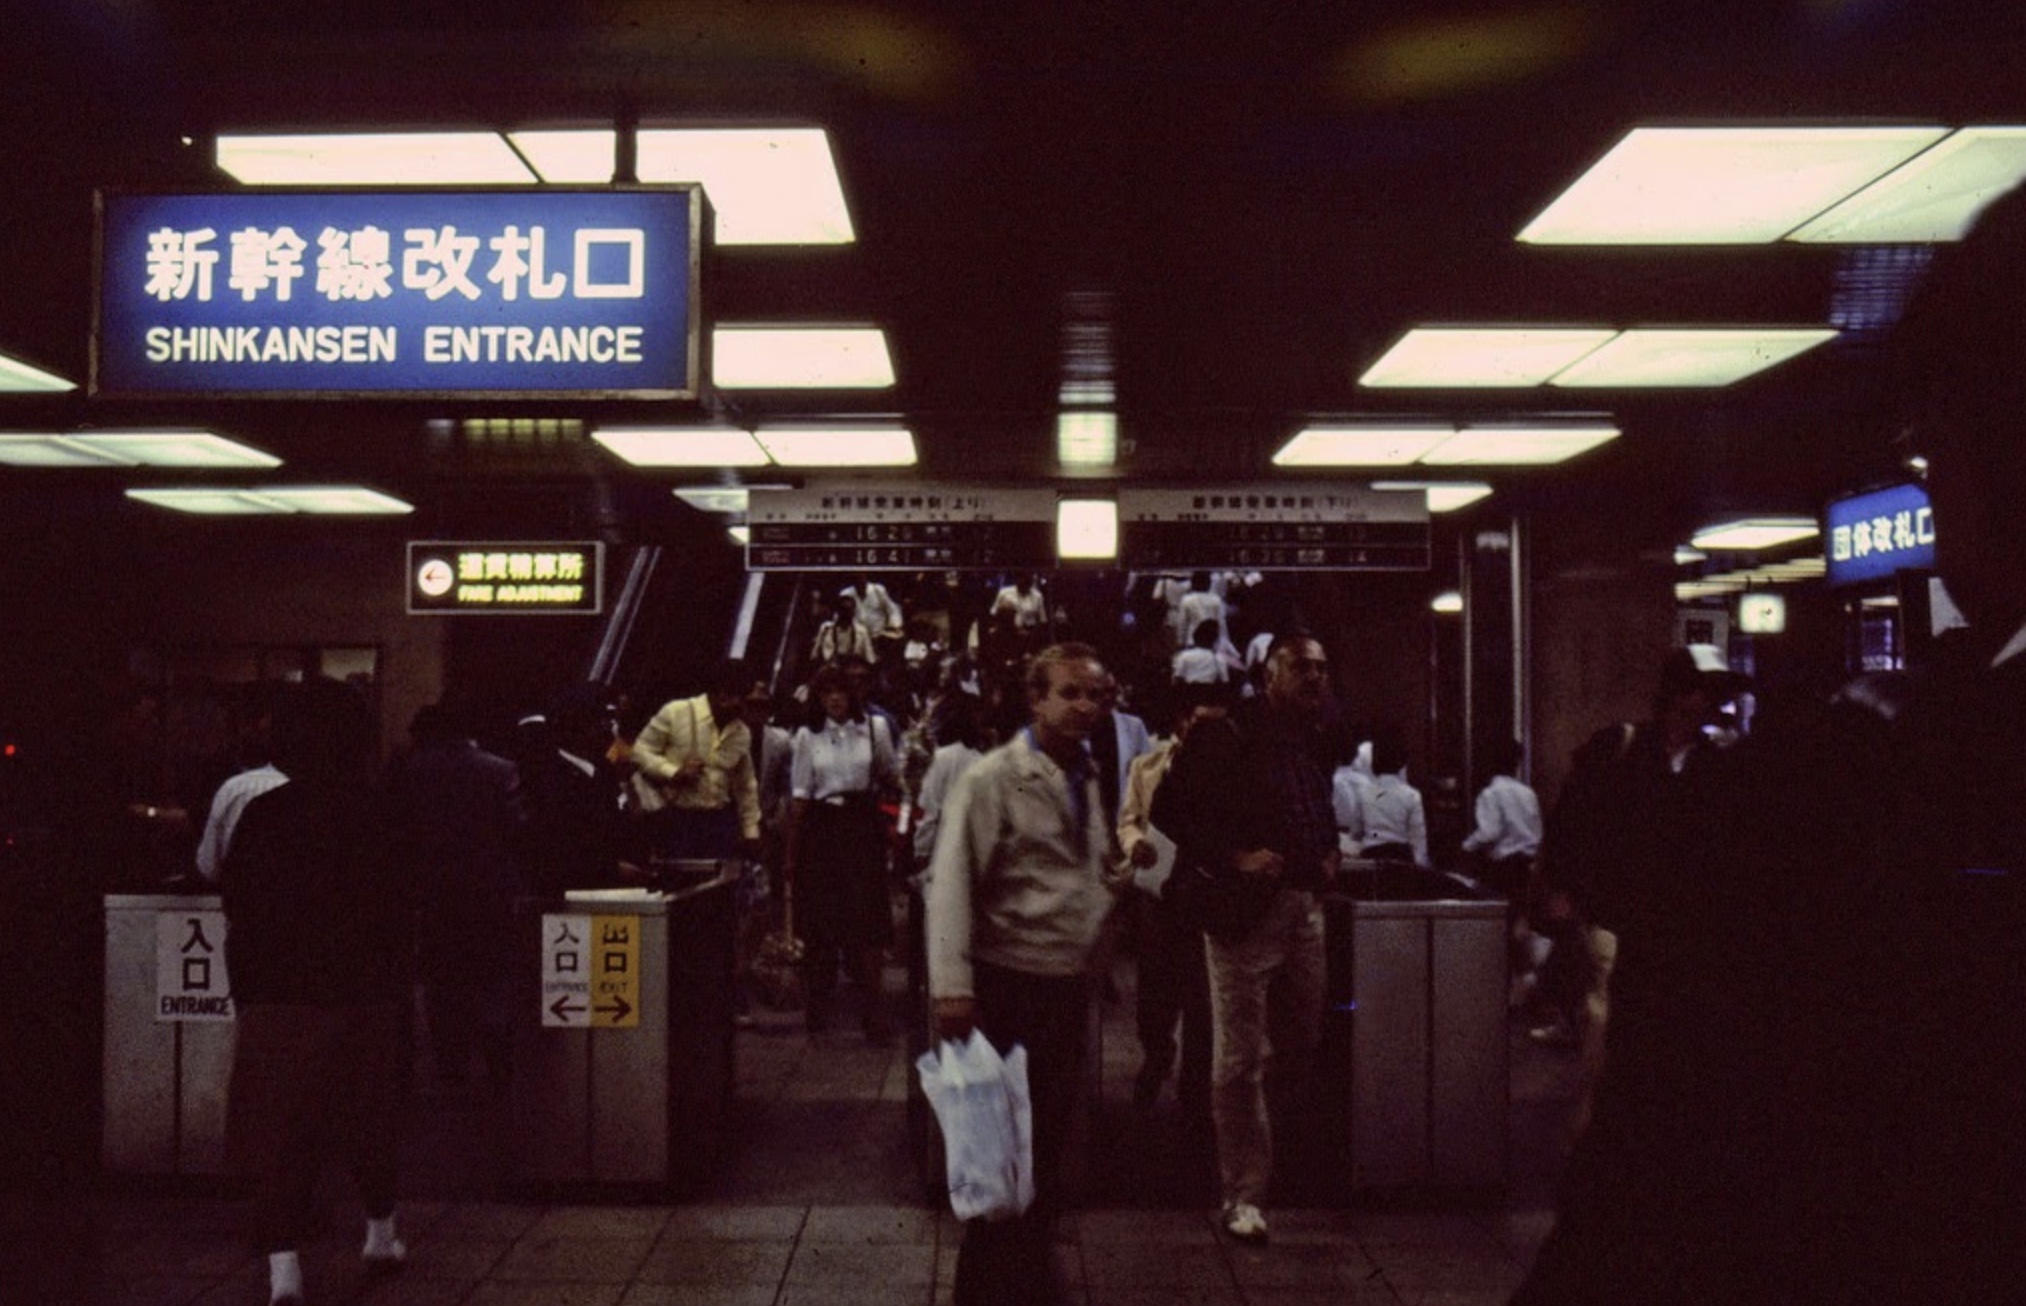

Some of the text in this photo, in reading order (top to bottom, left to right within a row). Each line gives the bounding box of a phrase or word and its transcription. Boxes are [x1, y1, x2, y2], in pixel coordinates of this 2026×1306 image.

[145, 226, 645, 302] 新幹線改札口
[145, 326, 644, 364] SHINKANSEN ENTRANCE
[181, 918, 214, 990] 入口
[554, 923, 580, 973] 入口
[602, 923, 629, 973] 出口
[161, 995, 231, 1017] ENTRANCE
